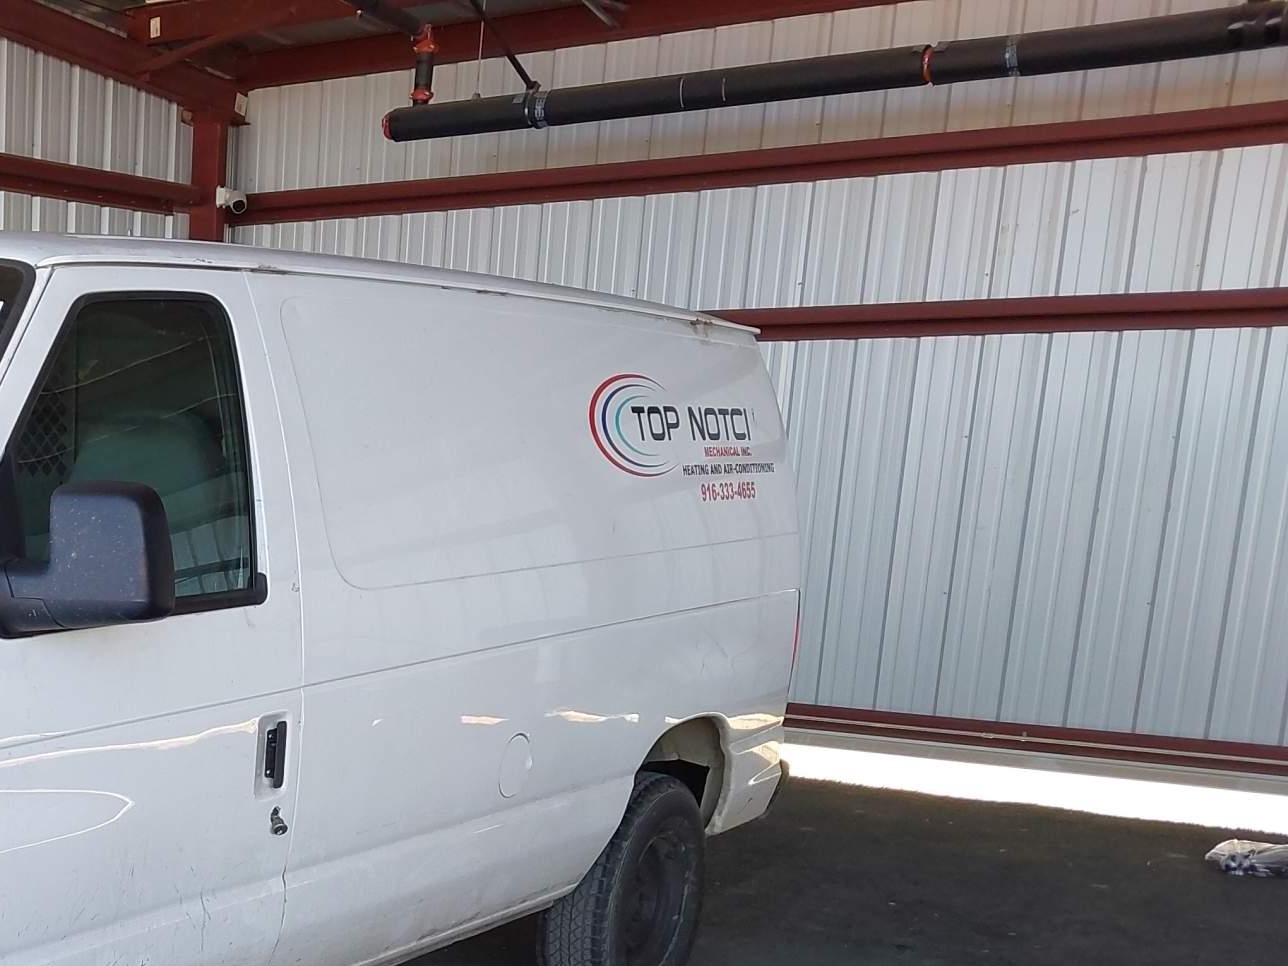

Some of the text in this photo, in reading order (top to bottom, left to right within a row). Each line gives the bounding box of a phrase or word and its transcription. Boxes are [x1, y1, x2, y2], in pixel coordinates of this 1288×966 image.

[630, 405, 680, 441] TOP
[704, 446, 740, 457] MECHANICAL
[682, 462, 775, 476] HEATING AND AIR-CONDITIONING
[701, 481, 756, 502] 916-333-4655
